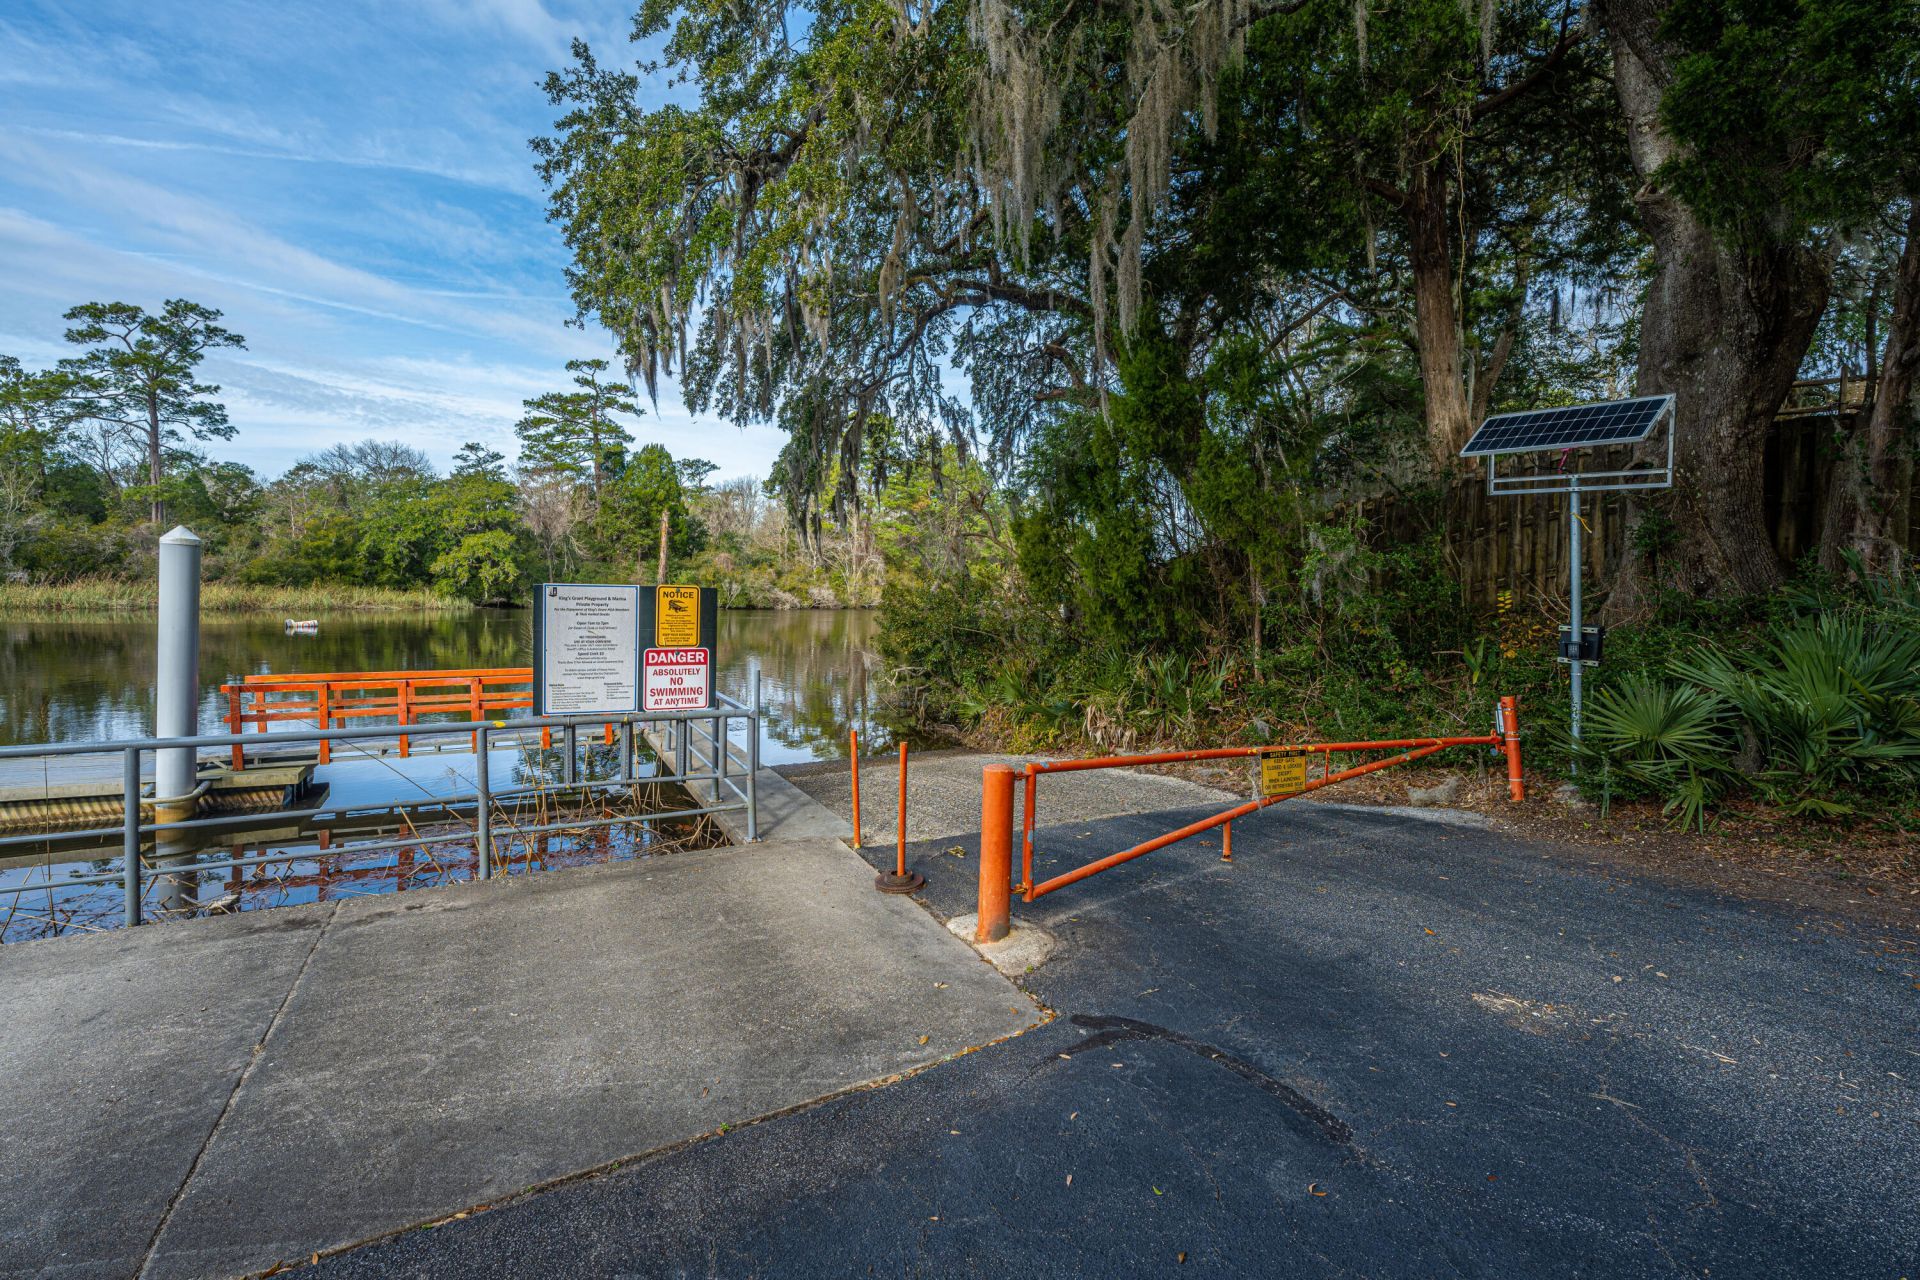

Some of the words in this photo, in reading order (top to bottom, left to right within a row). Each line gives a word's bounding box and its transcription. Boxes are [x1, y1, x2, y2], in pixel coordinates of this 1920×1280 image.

[648, 652, 704, 663] DANGER
[653, 668, 700, 676] ABSOLUTELY
[670, 677, 683, 685] NO
[650, 687, 703, 697] SWIMMING
